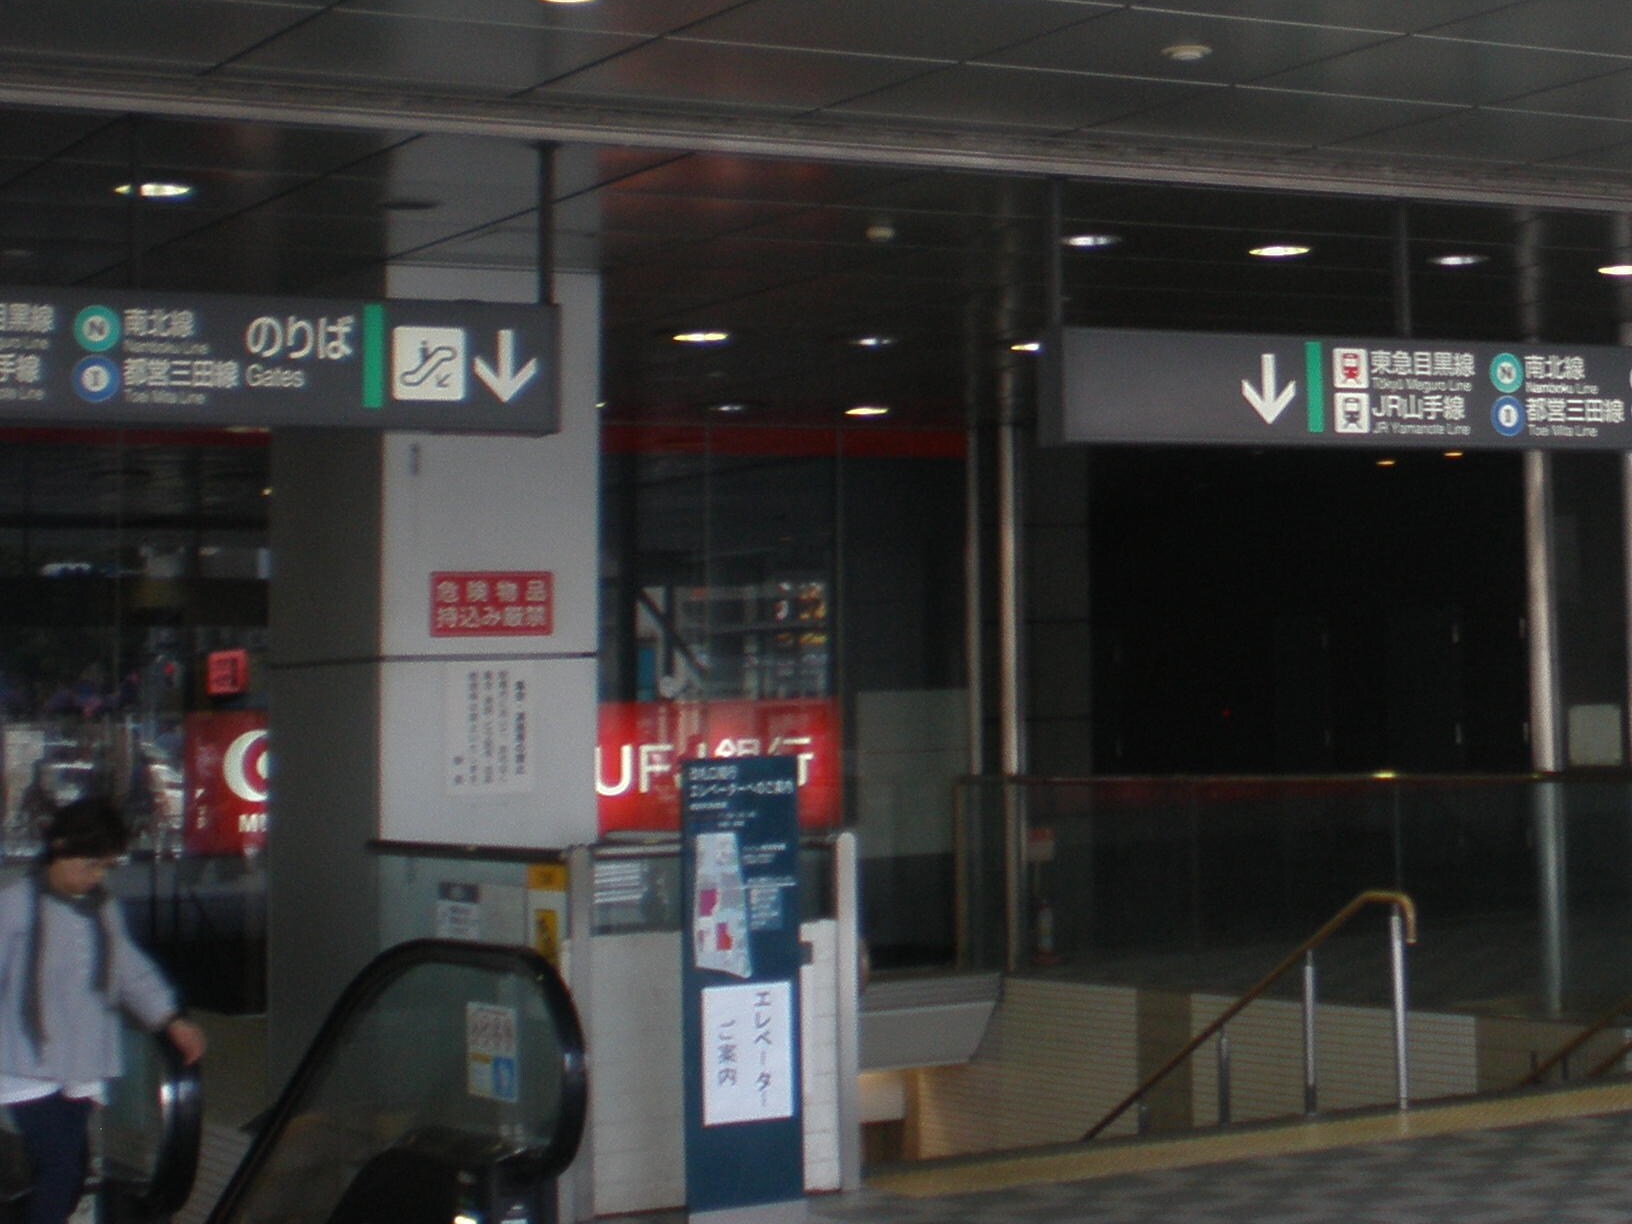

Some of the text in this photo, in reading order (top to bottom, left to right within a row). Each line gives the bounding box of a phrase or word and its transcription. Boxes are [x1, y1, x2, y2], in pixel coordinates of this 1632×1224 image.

[123, 307, 196, 338] 南北線
[246, 314, 355, 360] のりば
[123, 358, 240, 389] 都営三田線
[246, 363, 306, 388] Gates
[1370, 349, 1476, 378] 東急目黒線
[1524, 355, 1586, 380] 南北線
[1448, 379, 1473, 392] Line
[1371, 394, 1466, 421] JR山手線
[1525, 397, 1625, 424] 都営三田線
[1374, 421, 1389, 434] JR
[1446, 423, 1472, 436] Line
[753, 990, 773, 1108] エレベーター
